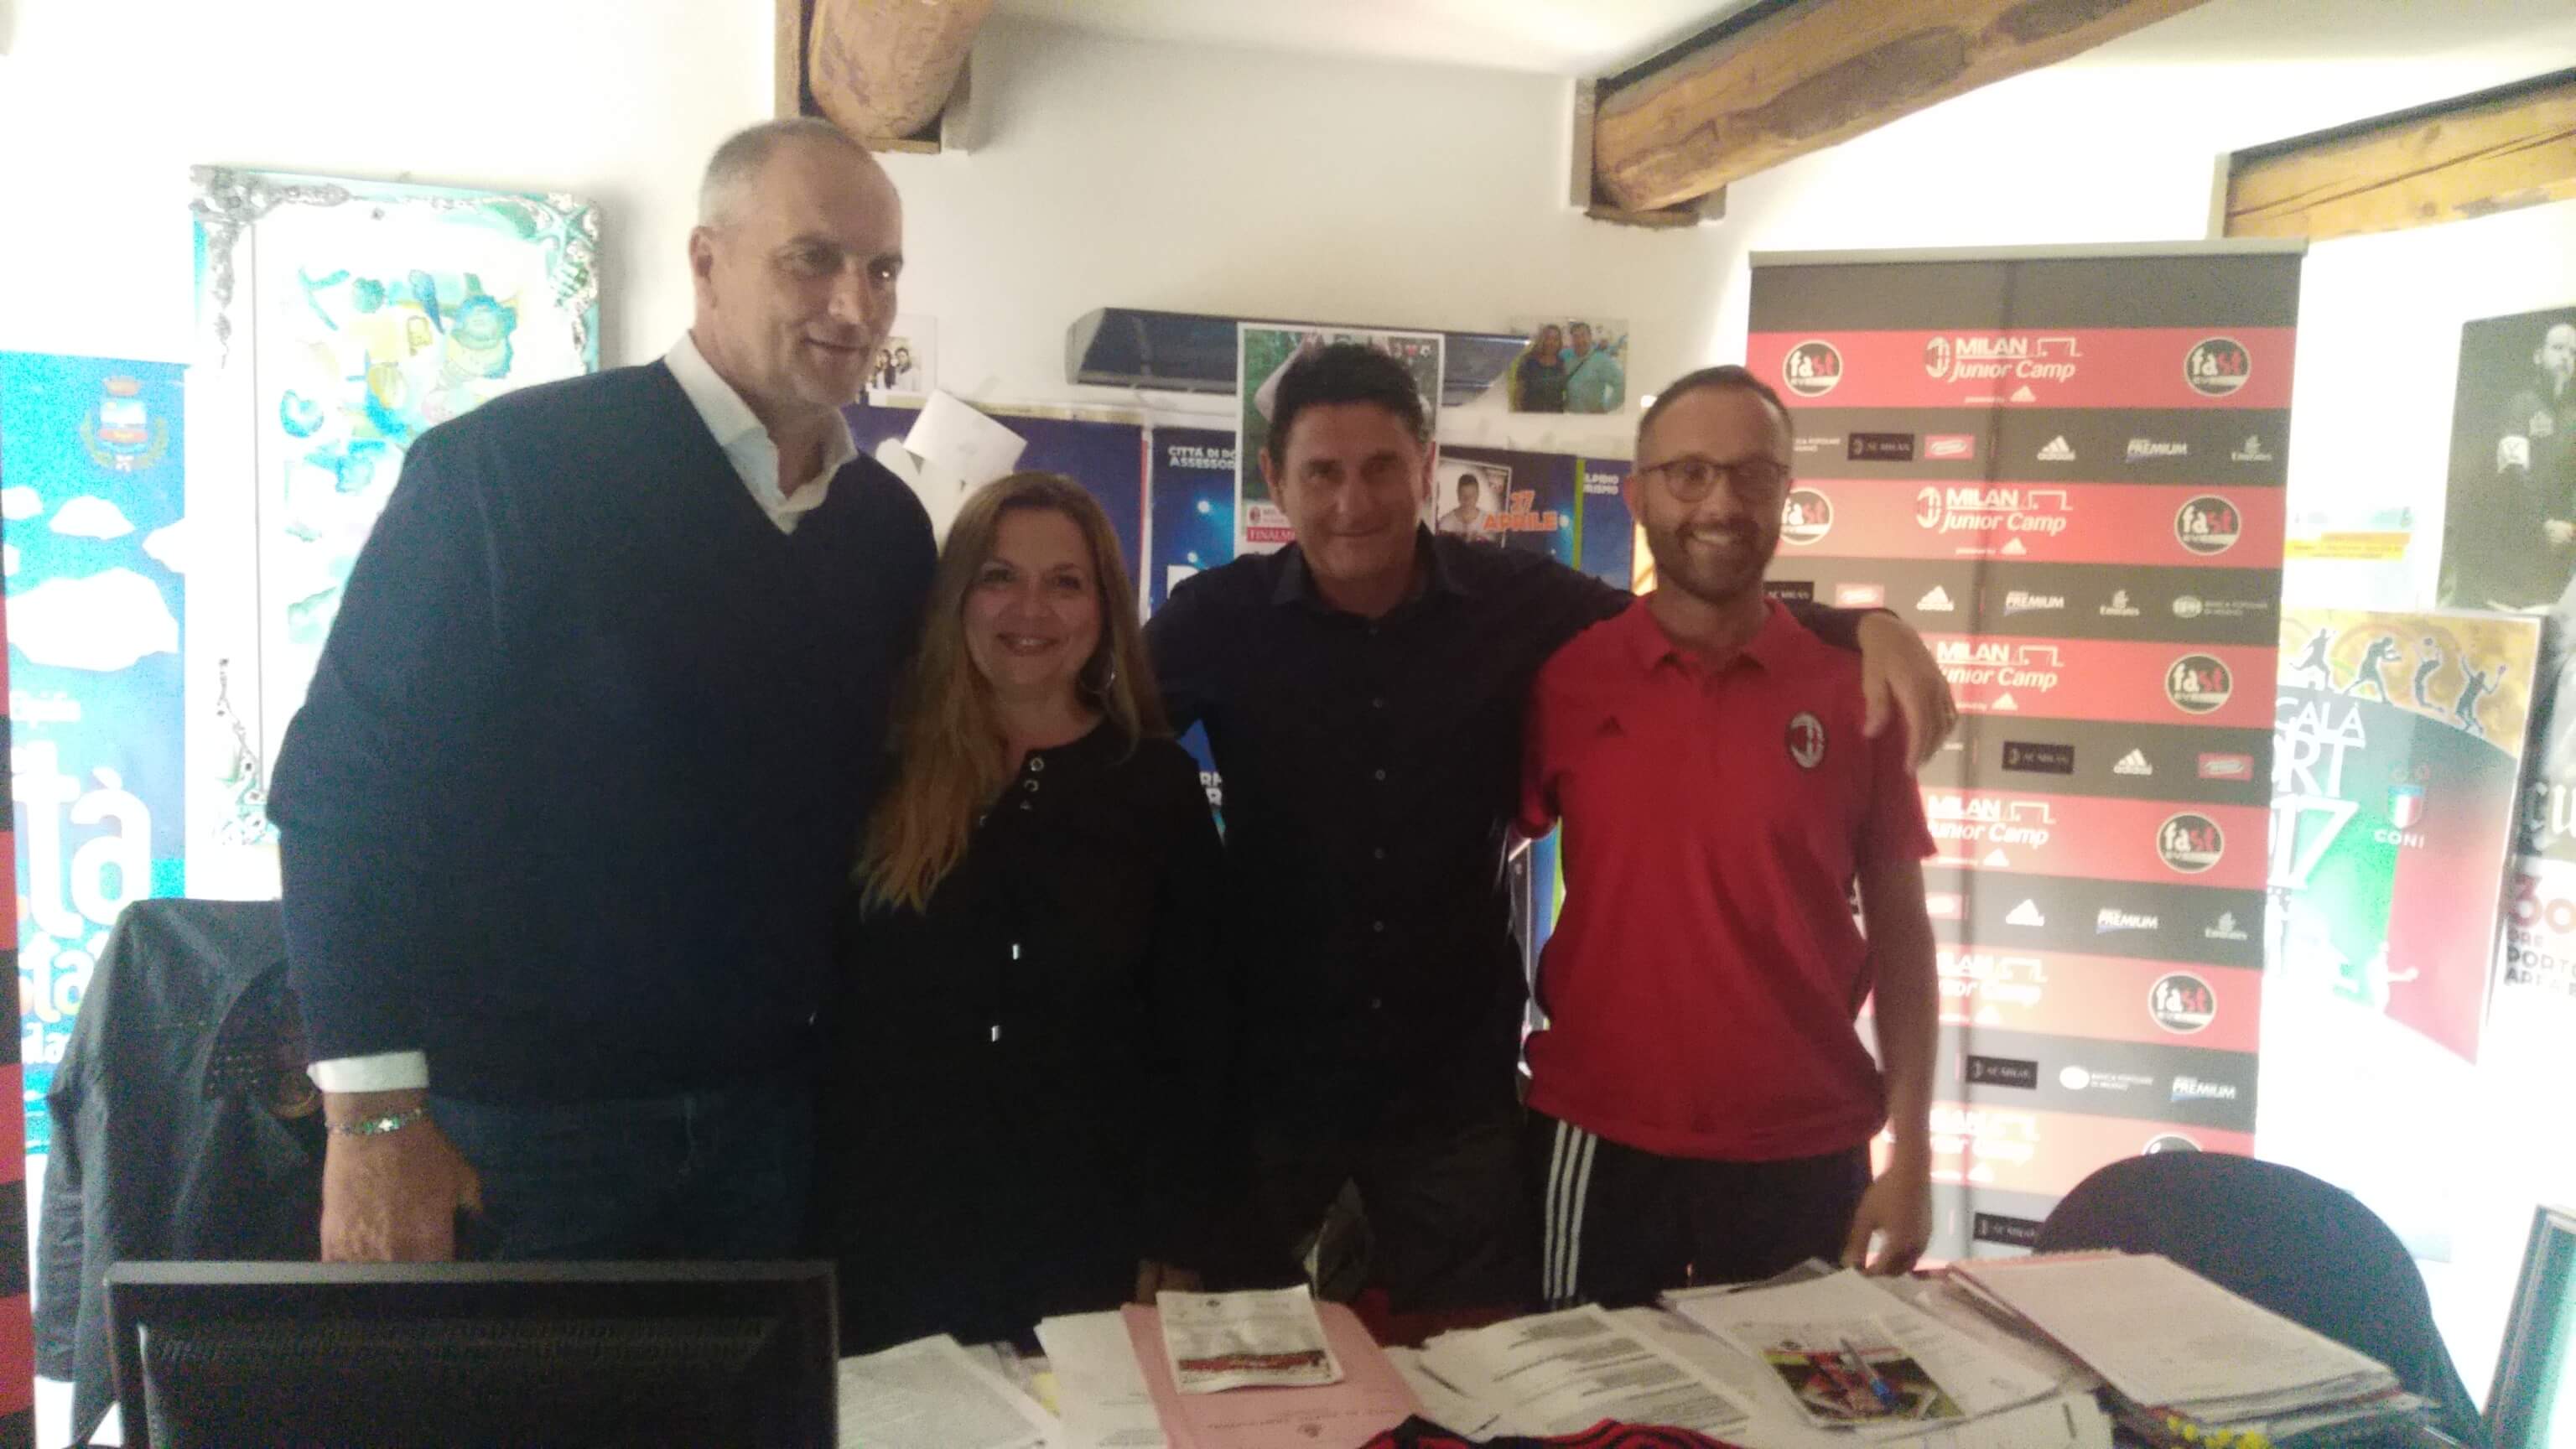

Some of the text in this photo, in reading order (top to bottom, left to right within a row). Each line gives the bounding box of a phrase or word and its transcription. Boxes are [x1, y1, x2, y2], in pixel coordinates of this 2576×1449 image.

[1955, 337, 2027, 356] MILAN
[1789, 350, 1836, 377] fast
[1949, 360, 2076, 383] Junior Camp
[2191, 347, 2242, 376] fast
[1945, 488, 2018, 508] MILAN
[1483, 511, 1558, 532] APRILE
[1939, 512, 2066, 537] Junior Camp
[2181, 504, 2232, 534] fast
[1937, 641, 2009, 662] MILAN
[1997, 667, 2059, 693] Camp
[2173, 662, 2224, 693] fast
[1988, 823, 2049, 849] Camp
[2164, 822, 2215, 852] fast
[2374, 829, 2425, 849] CONI
